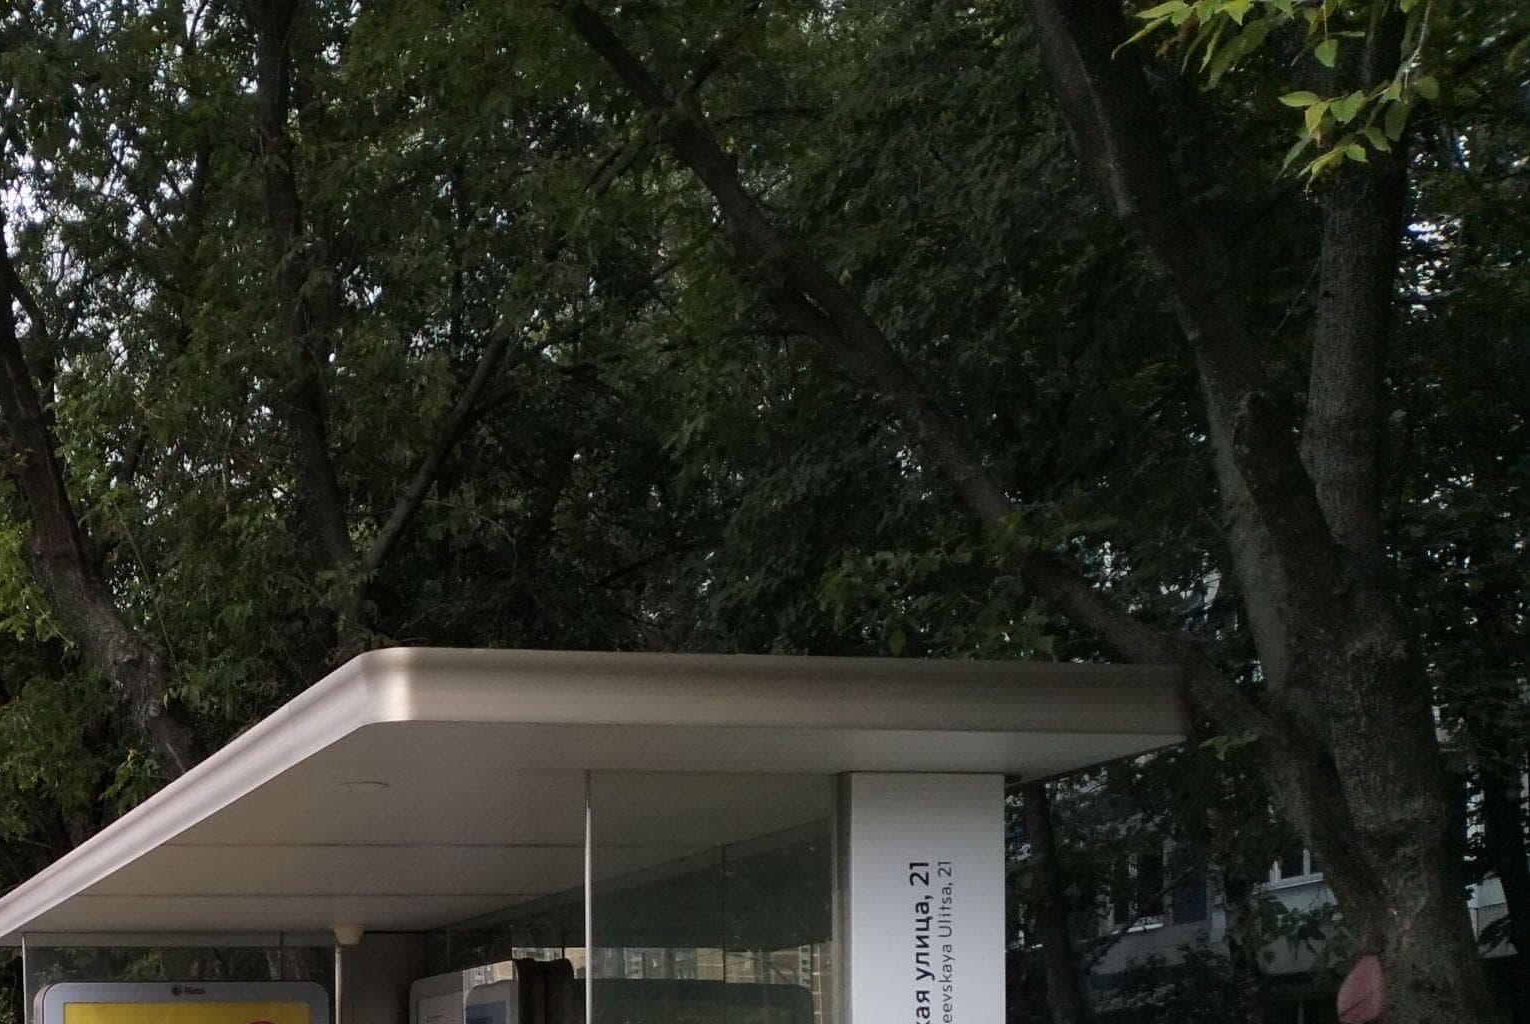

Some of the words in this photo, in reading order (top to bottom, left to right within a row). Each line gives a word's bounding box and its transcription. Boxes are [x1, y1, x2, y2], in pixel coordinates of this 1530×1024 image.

[909, 862, 929, 886] 21
[938, 861, 952, 877] 21
[937, 882, 953, 937] Ulitsa,
[915, 895, 935, 980] улица,
